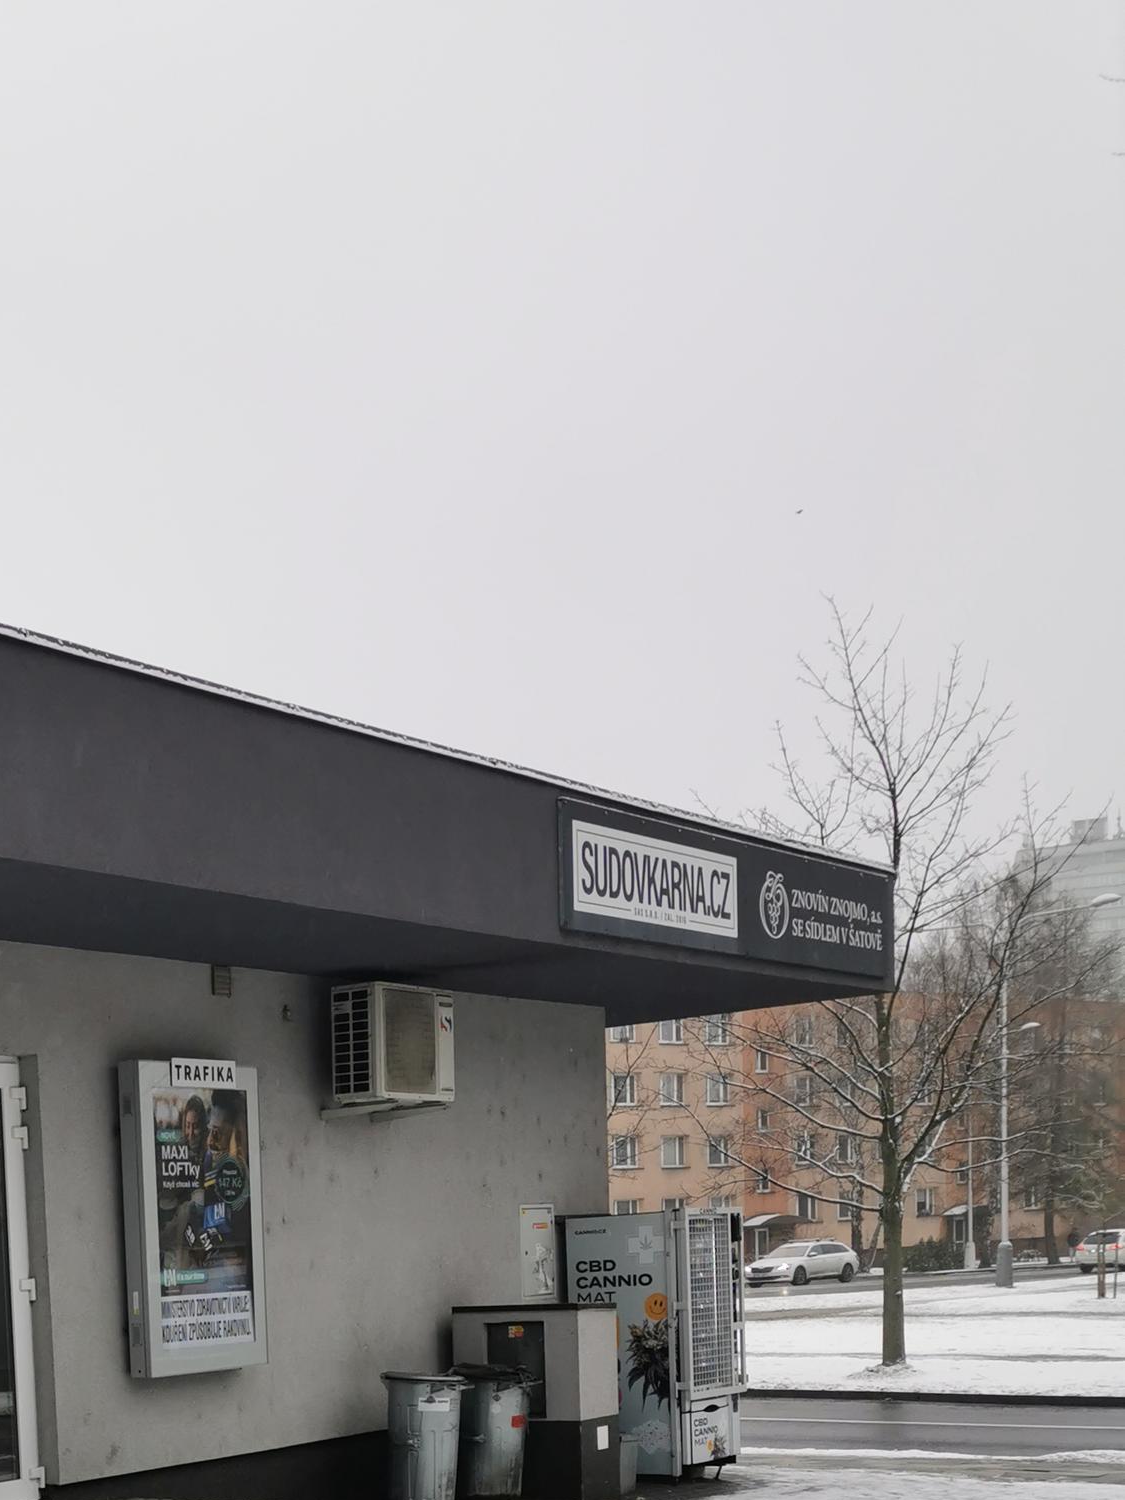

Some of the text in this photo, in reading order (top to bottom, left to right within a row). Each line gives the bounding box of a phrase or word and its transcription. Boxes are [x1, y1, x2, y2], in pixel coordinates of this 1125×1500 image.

[581, 840, 731, 920] SUDOVKARNA.CZ
[791, 889, 829, 913] ZNOVÍN
[792, 916, 883, 951] SE SÍDLEM V ŠATOVĚ
[174, 1064, 234, 1082] TRAFIKA
[161, 1145, 188, 1160] MAXI
[162, 1162, 201, 1179] LOFTky
[575, 1259, 616, 1273] CBD
[576, 1273, 653, 1289] CANNIO
[577, 1291, 616, 1303] MAT
